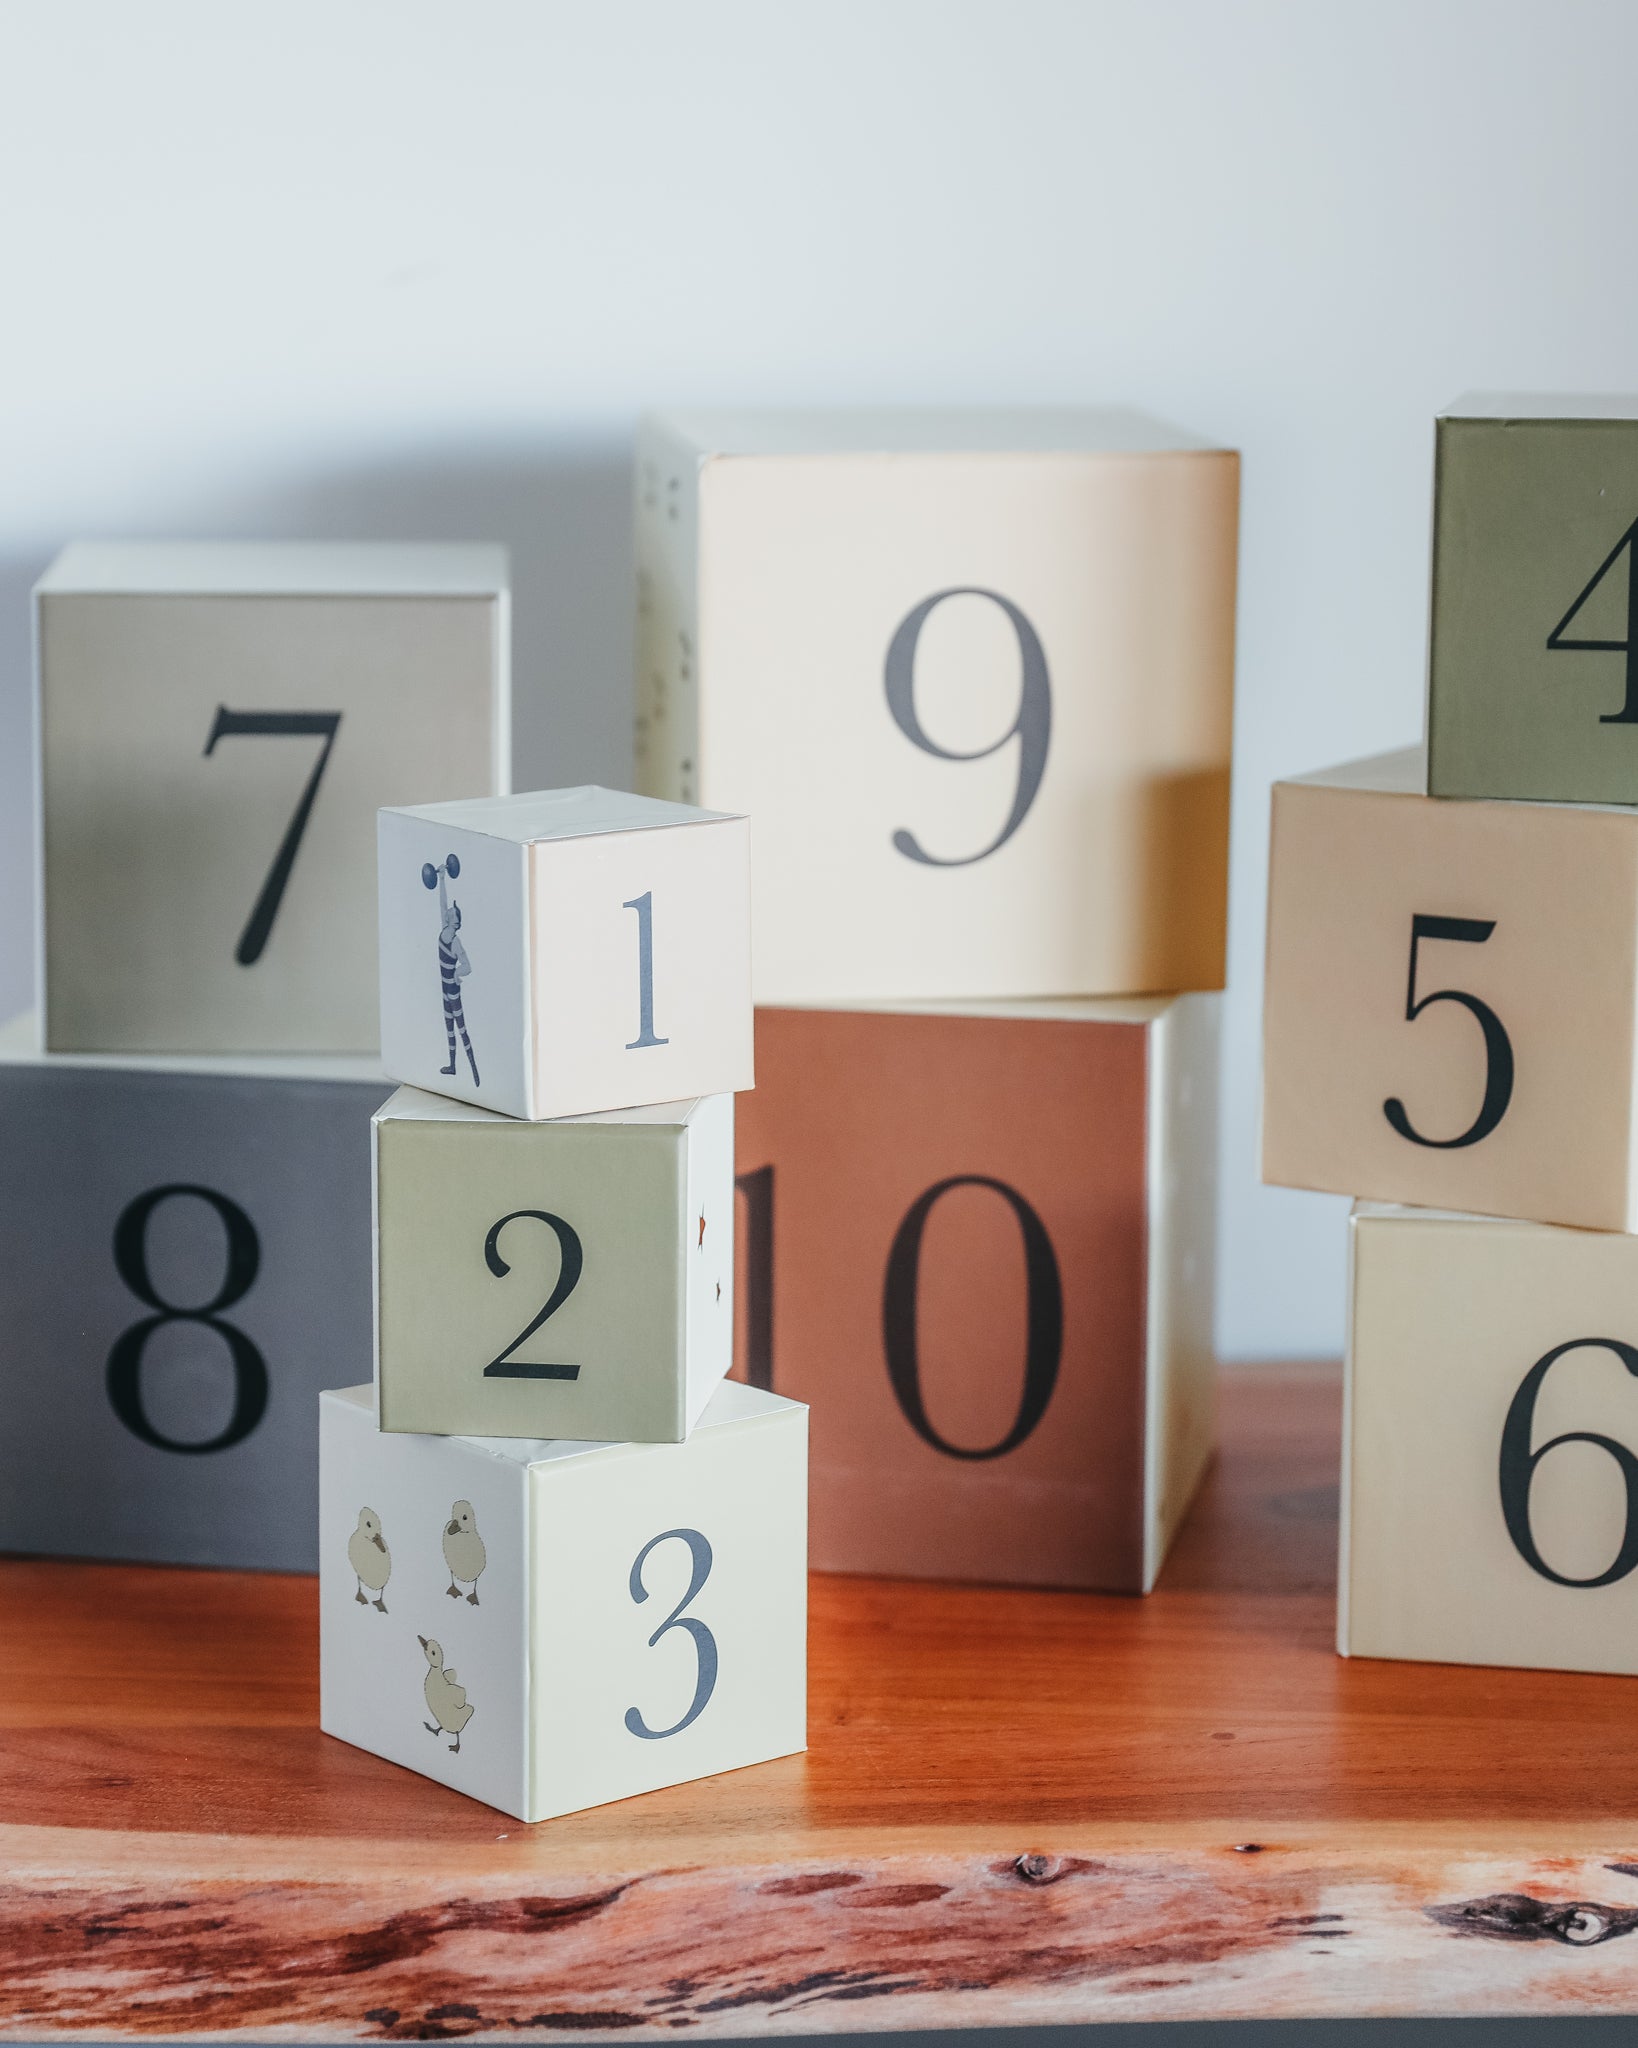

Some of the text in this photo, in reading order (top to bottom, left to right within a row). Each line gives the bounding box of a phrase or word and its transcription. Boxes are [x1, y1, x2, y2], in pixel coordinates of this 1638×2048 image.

[884, 586, 1053, 867] 9
[1547, 514, 1638, 723] 4
[203, 703, 344, 969] 7
[622, 890, 669, 1050] 1
[1383, 913, 1514, 1150] 5
[105, 1183, 270, 1457] 8
[484, 1209, 583, 1380] 2
[735, 1163, 1066, 1463] 10
[1498, 1337, 1638, 1588] 6
[624, 1528, 719, 1740] 3
